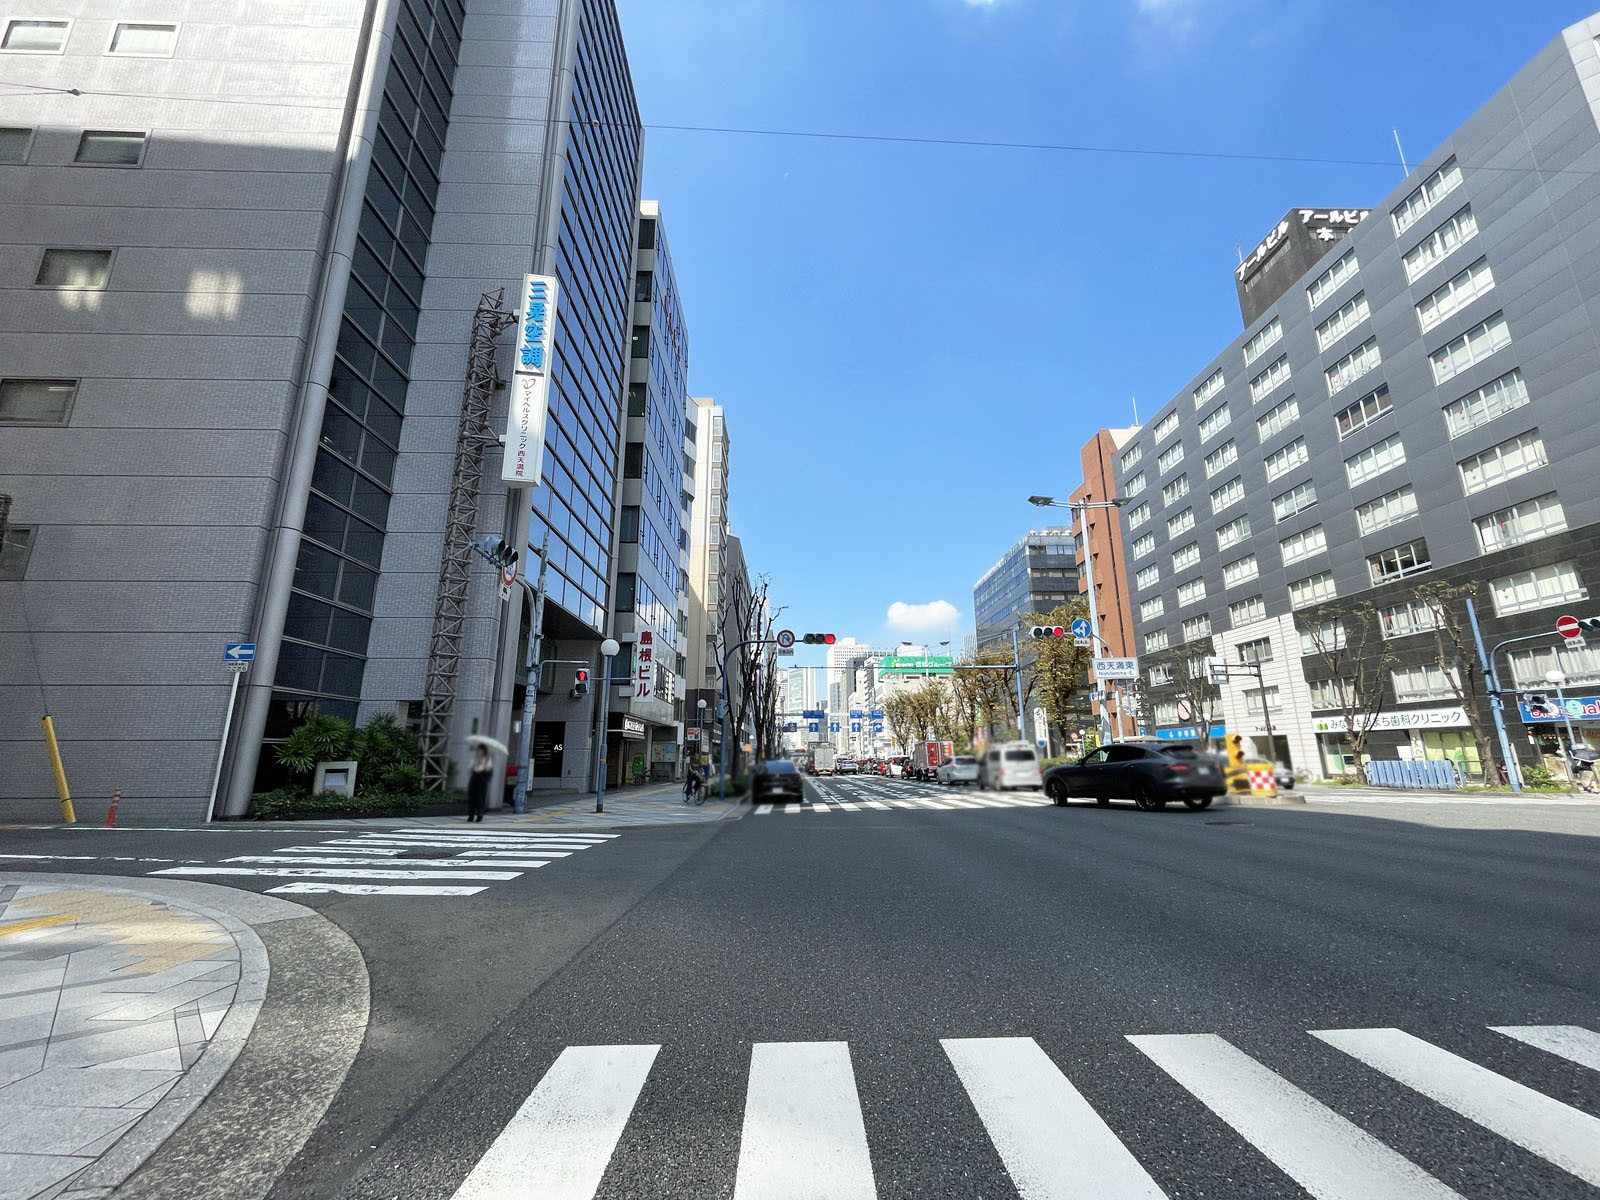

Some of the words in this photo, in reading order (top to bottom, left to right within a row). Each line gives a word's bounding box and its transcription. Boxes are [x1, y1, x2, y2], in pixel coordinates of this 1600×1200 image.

[1235, 220, 1289, 281] アールビル
[520, 281, 547, 369] 三晃空調
[518, 390, 532, 449] マイヘルスクリニック
[636, 630, 653, 697] 島根ビル
[1096, 661, 1135, 671] 西天満東
